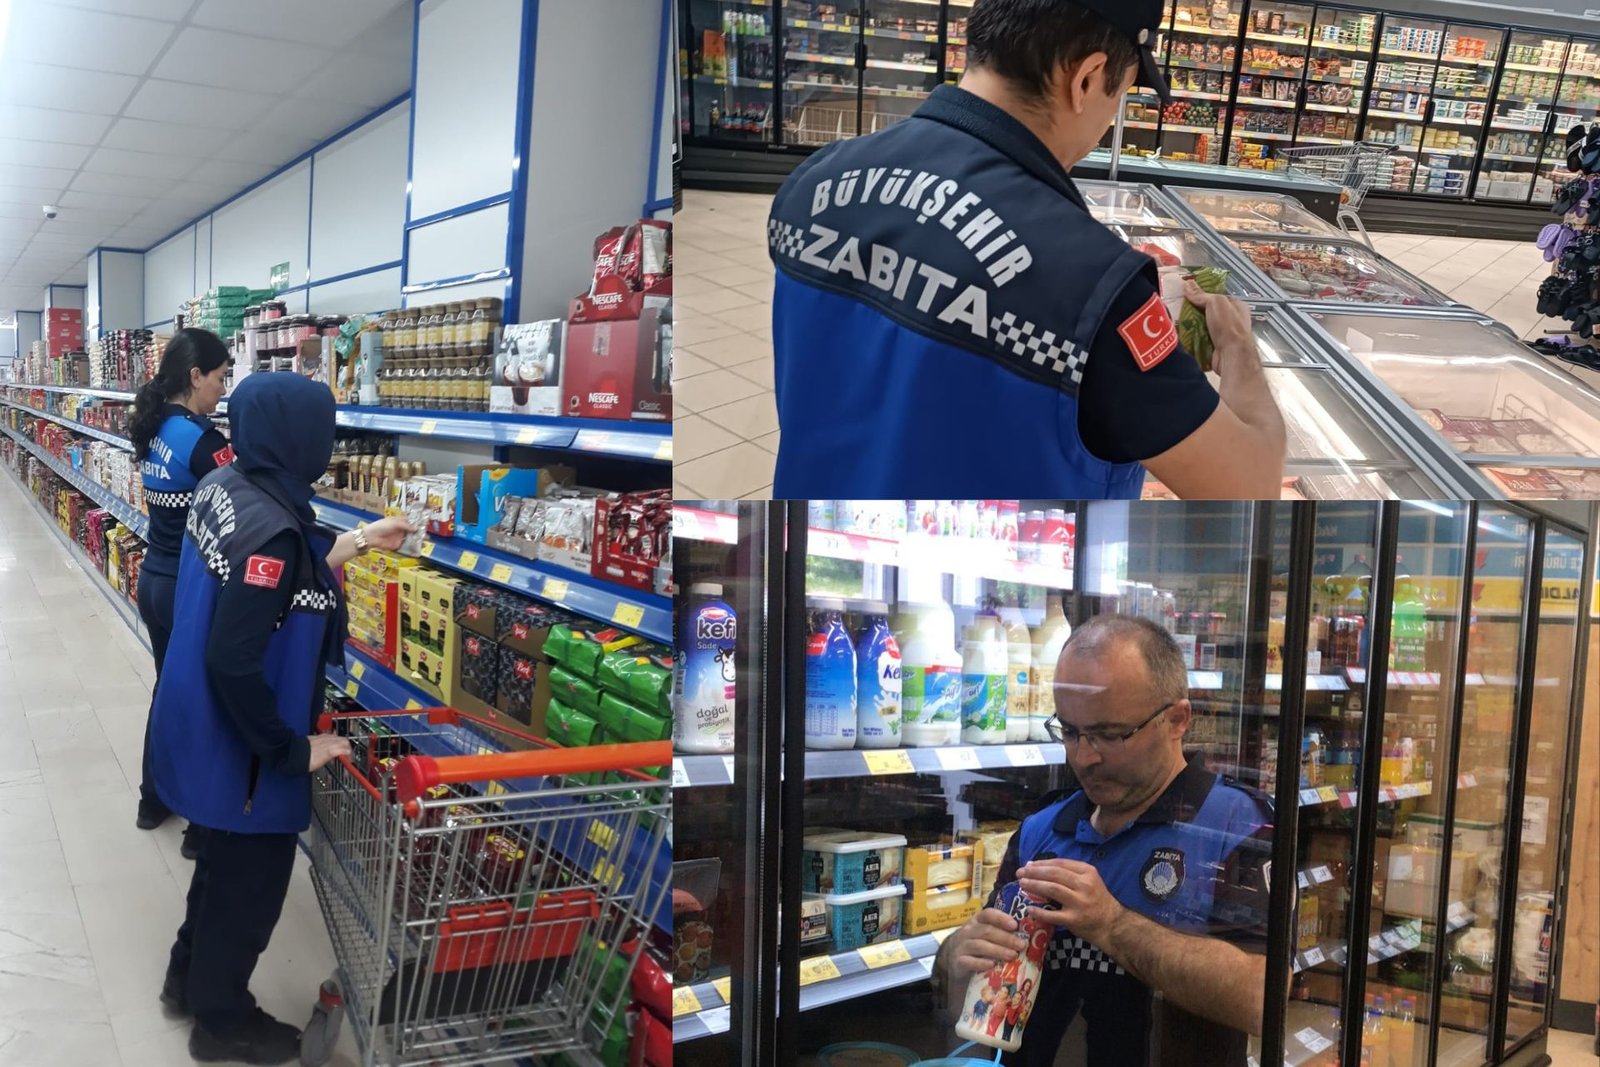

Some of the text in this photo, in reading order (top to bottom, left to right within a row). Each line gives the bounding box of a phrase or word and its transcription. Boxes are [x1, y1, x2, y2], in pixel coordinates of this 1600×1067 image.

[811, 167, 1033, 288] BÜYÜKŞEHİR
[799, 223, 988, 339] ZABITA
[697, 703, 729, 719] doğal
[1153, 851, 1181, 862] ZABITA
